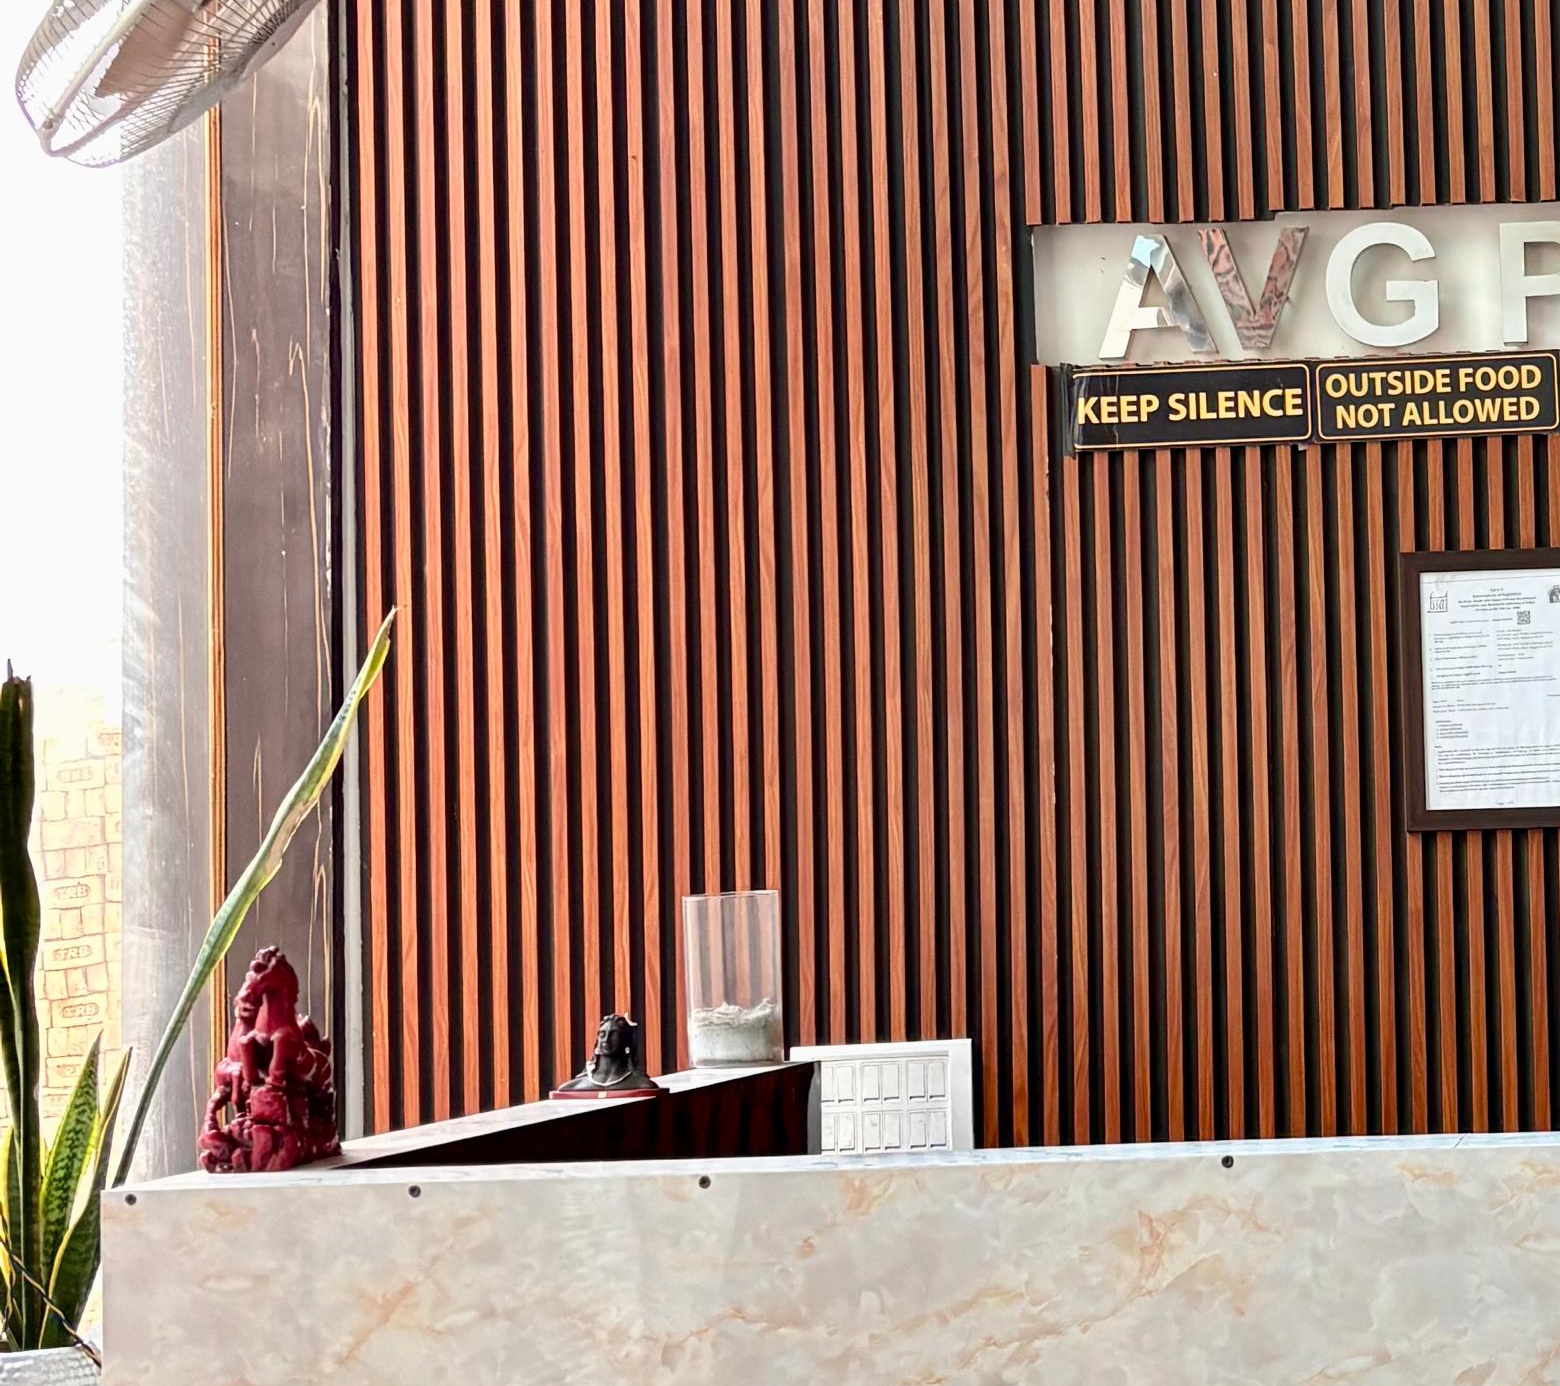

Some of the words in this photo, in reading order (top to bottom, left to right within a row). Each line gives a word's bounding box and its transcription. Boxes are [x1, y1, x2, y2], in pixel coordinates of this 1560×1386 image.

[1098, 221, 1440, 359] AVG
[1325, 369, 1452, 398] OUTSIDE
[1458, 364, 1542, 392] FOOD
[1077, 394, 1160, 425] KEEP
[1168, 388, 1303, 421] SILENCE
[1336, 403, 1395, 429] NOT
[1402, 396, 1540, 426] ALLOWED
